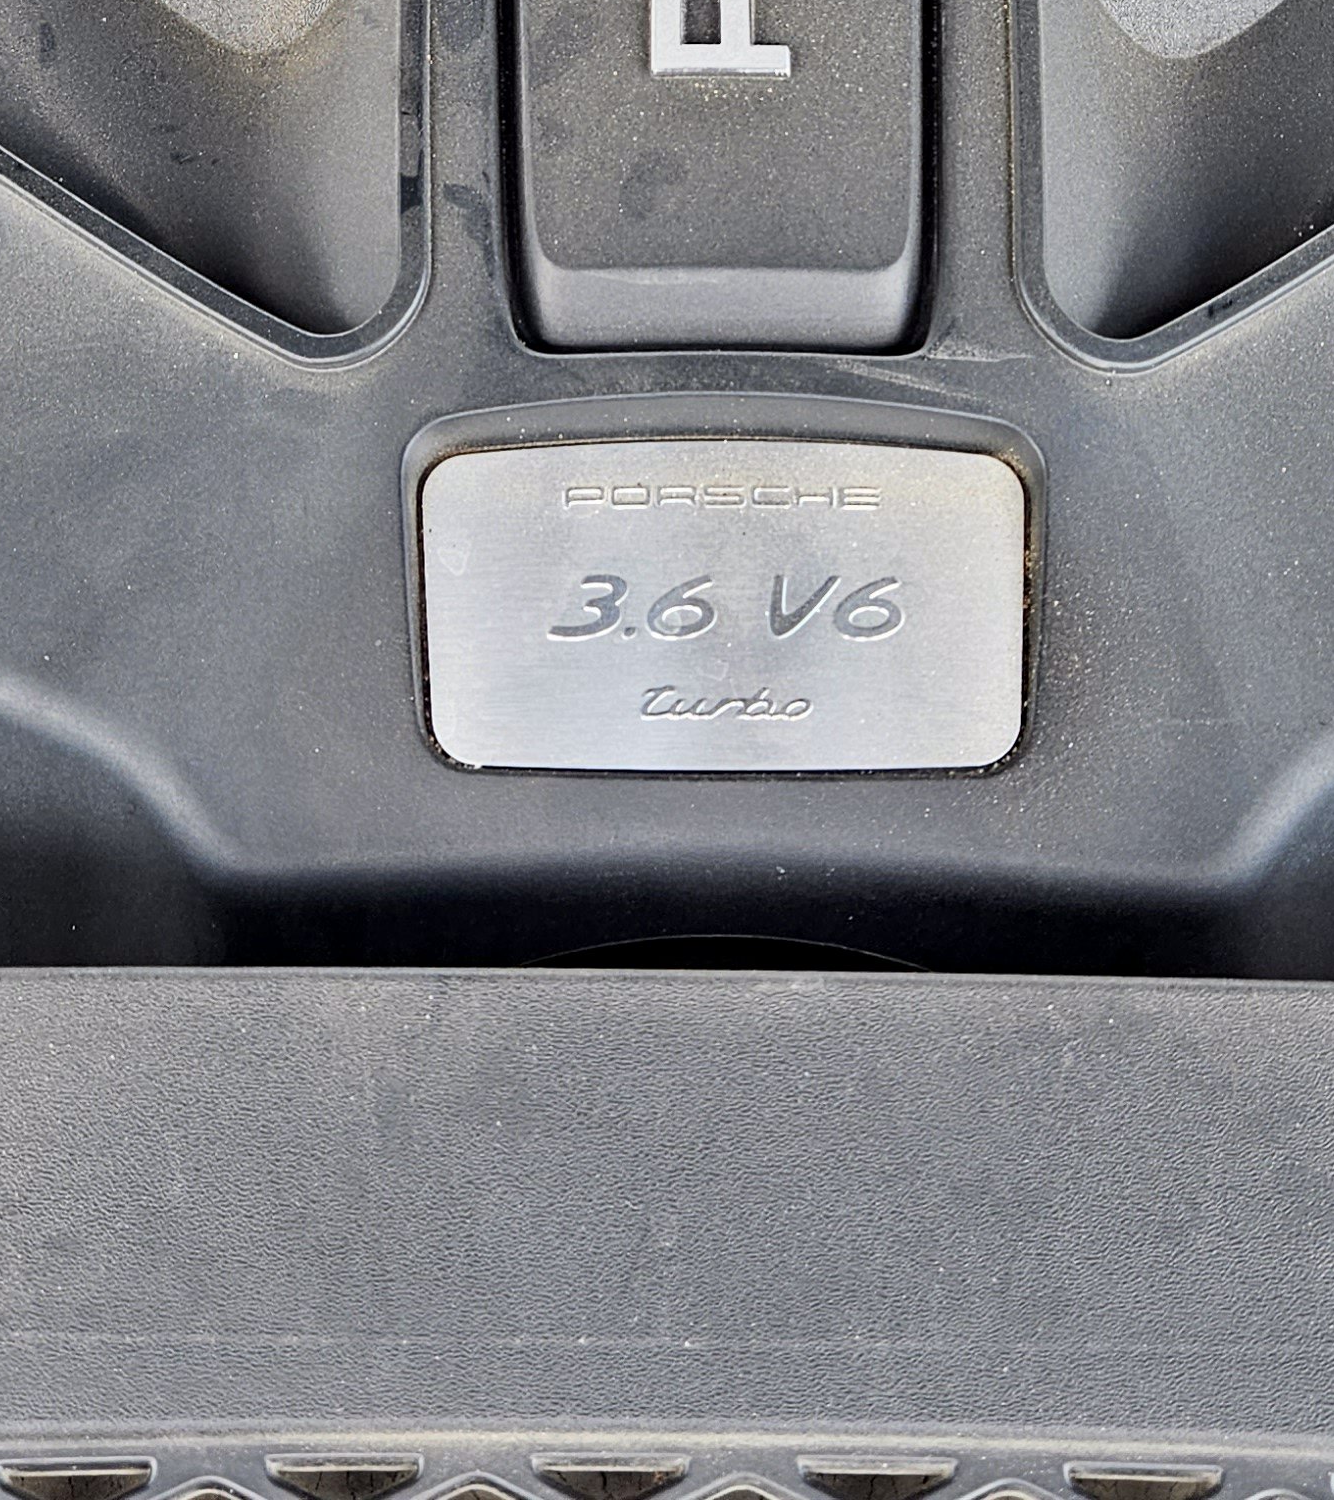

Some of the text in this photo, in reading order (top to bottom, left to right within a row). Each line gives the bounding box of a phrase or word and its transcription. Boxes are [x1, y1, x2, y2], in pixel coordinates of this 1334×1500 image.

[561, 482, 882, 510] PORSCHE
[546, 573, 906, 642] 3.6 V6
